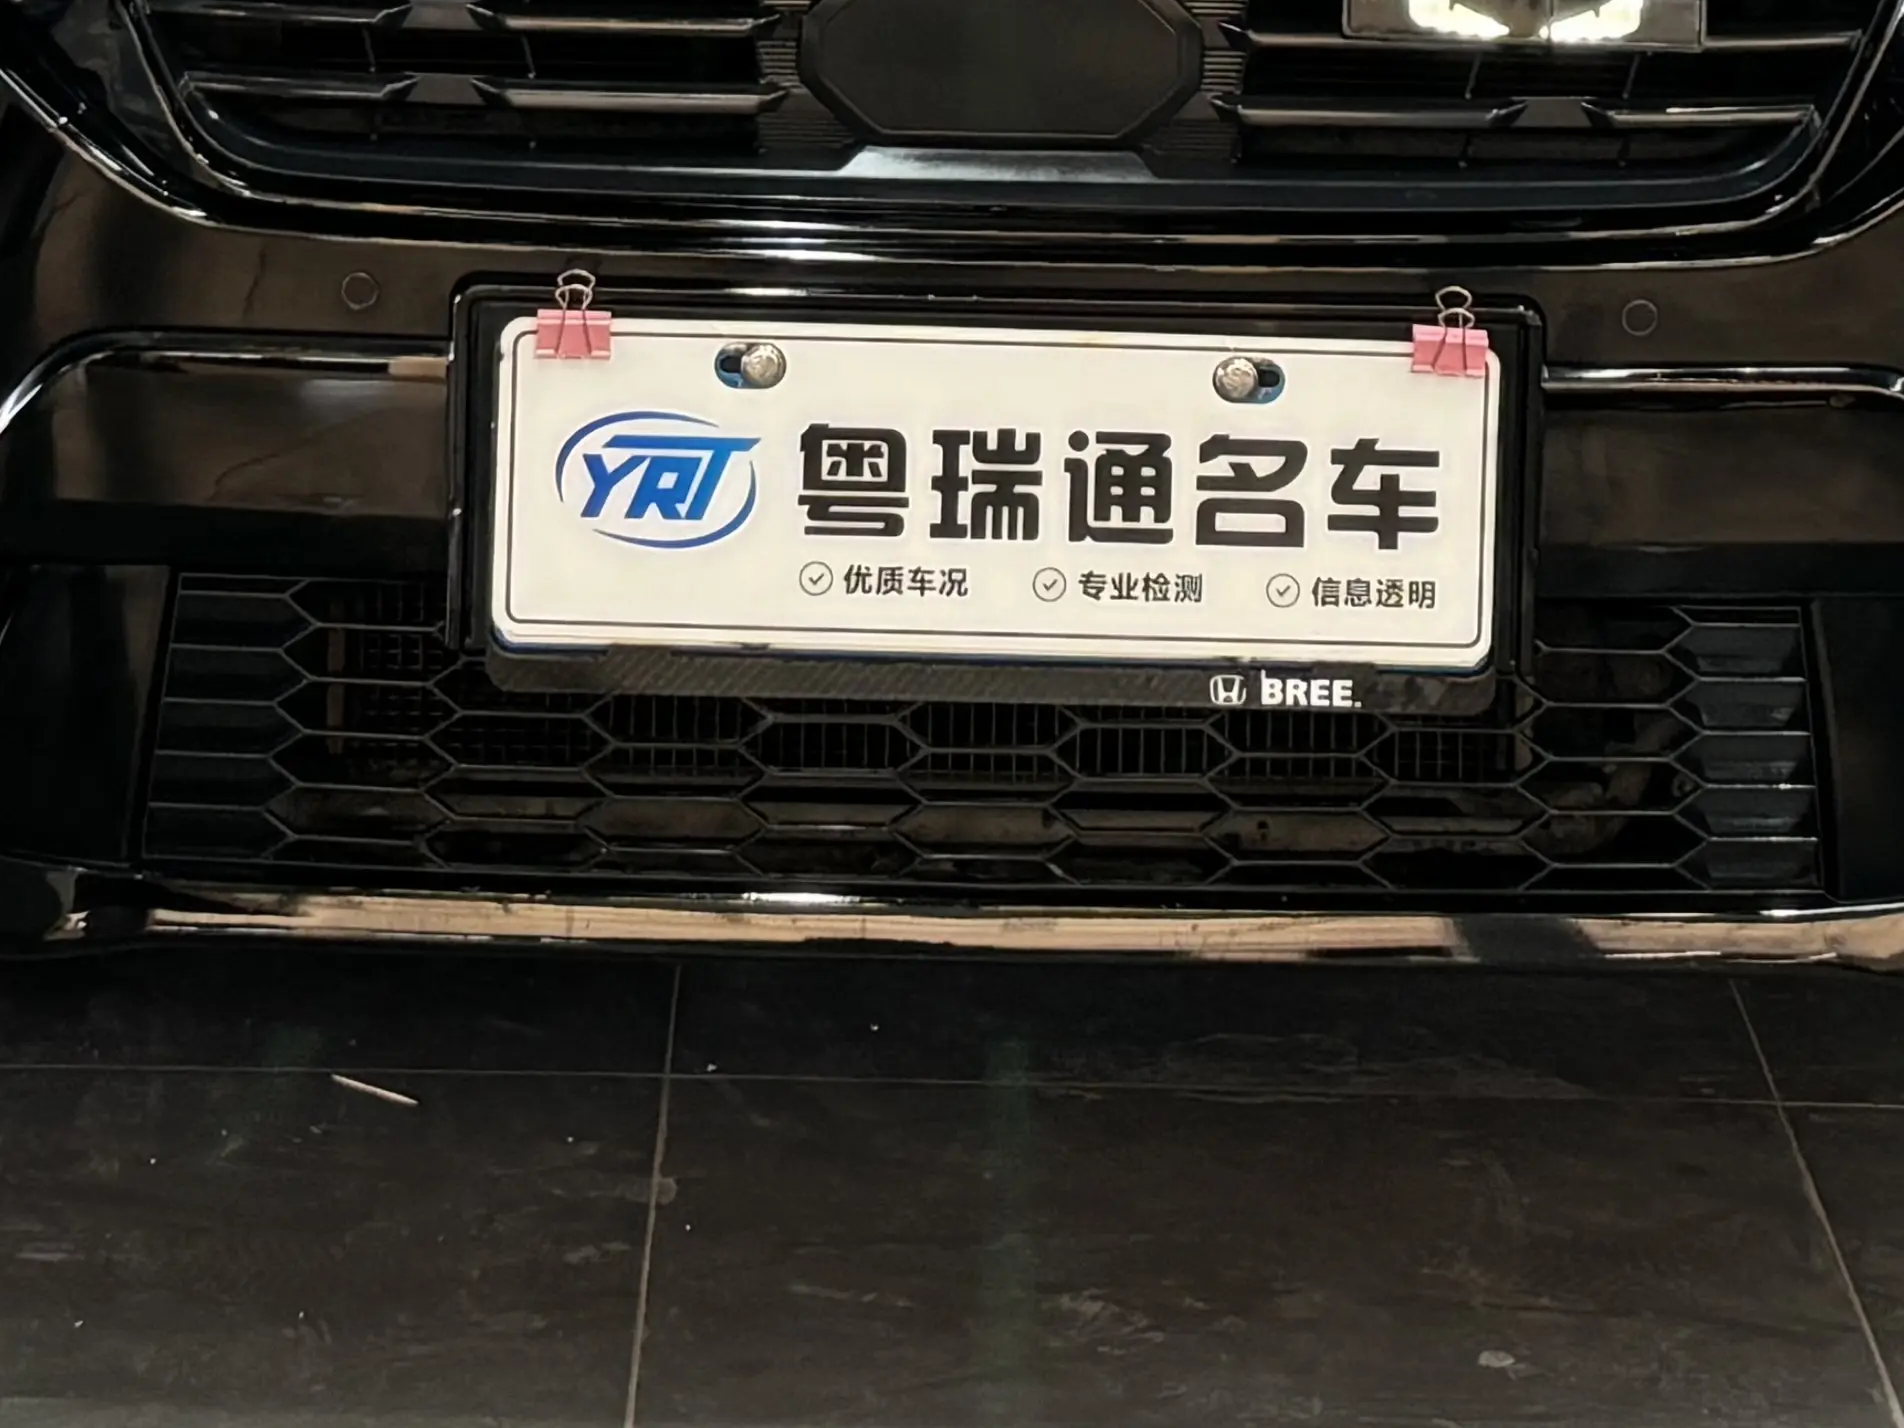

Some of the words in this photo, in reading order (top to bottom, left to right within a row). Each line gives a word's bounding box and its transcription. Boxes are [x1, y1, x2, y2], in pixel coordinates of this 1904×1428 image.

[580, 434, 762, 521] YRT
[798, 422, 1441, 550] 粤瑞通名车
[844, 564, 969, 597] 优质车况
[1077, 570, 1203, 603] 专业检测
[1311, 576, 1436, 609] 信息透明
